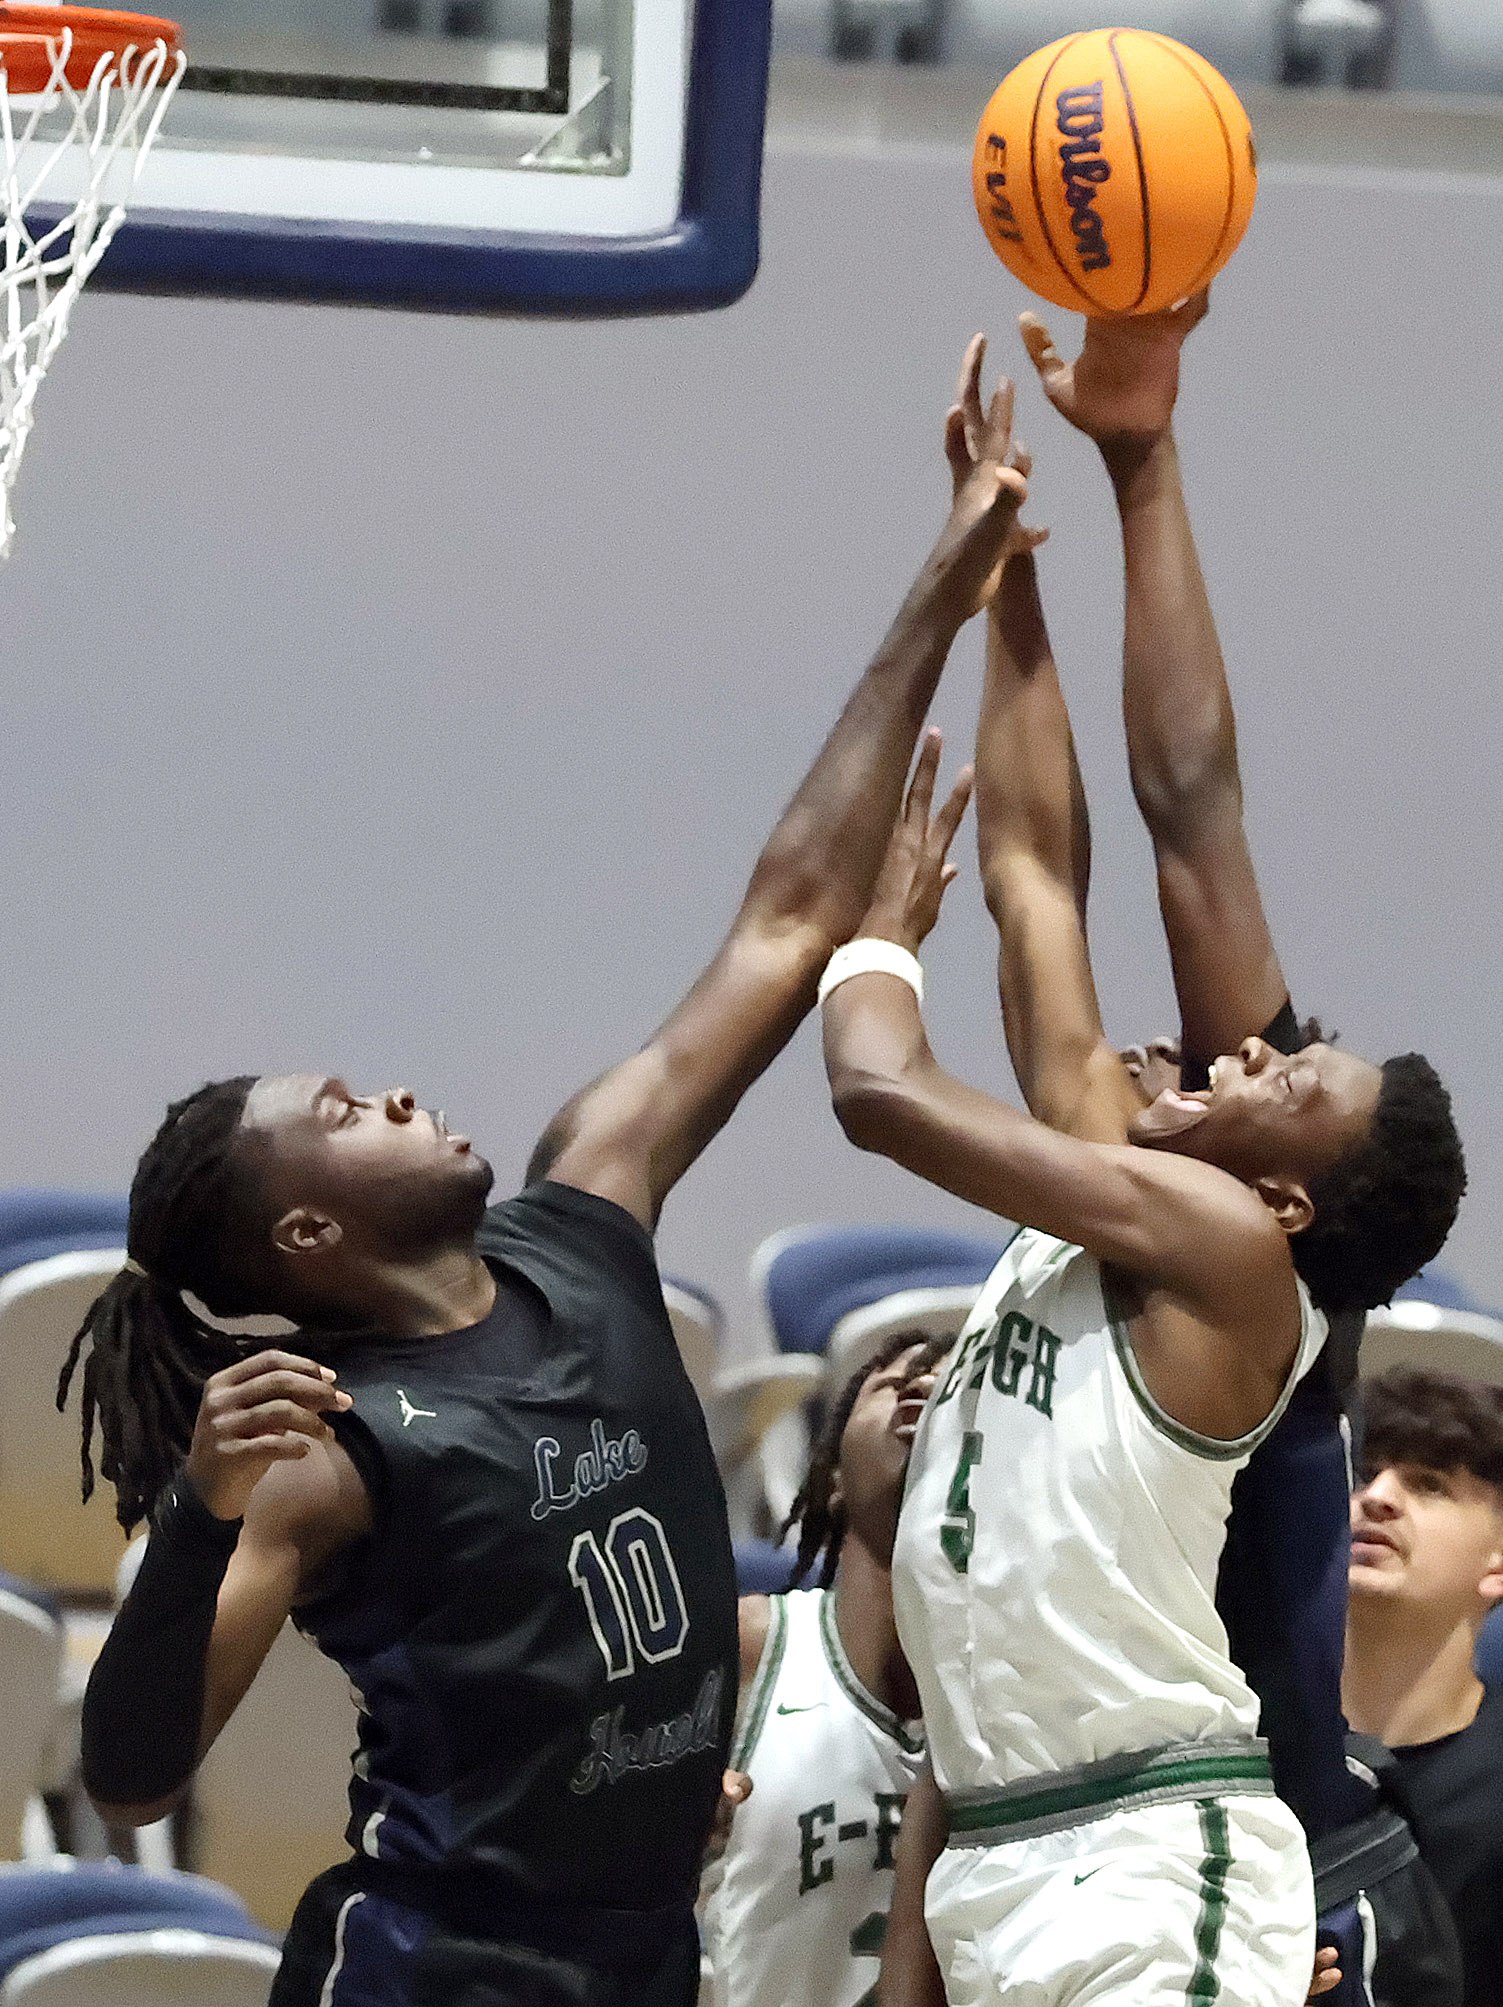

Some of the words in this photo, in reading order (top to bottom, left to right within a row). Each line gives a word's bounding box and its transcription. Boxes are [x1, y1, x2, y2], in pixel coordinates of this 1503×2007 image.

[1056, 79, 1111, 272] Wilson
[531, 1418, 648, 1520] Lake
[567, 1506, 690, 1681] 10
